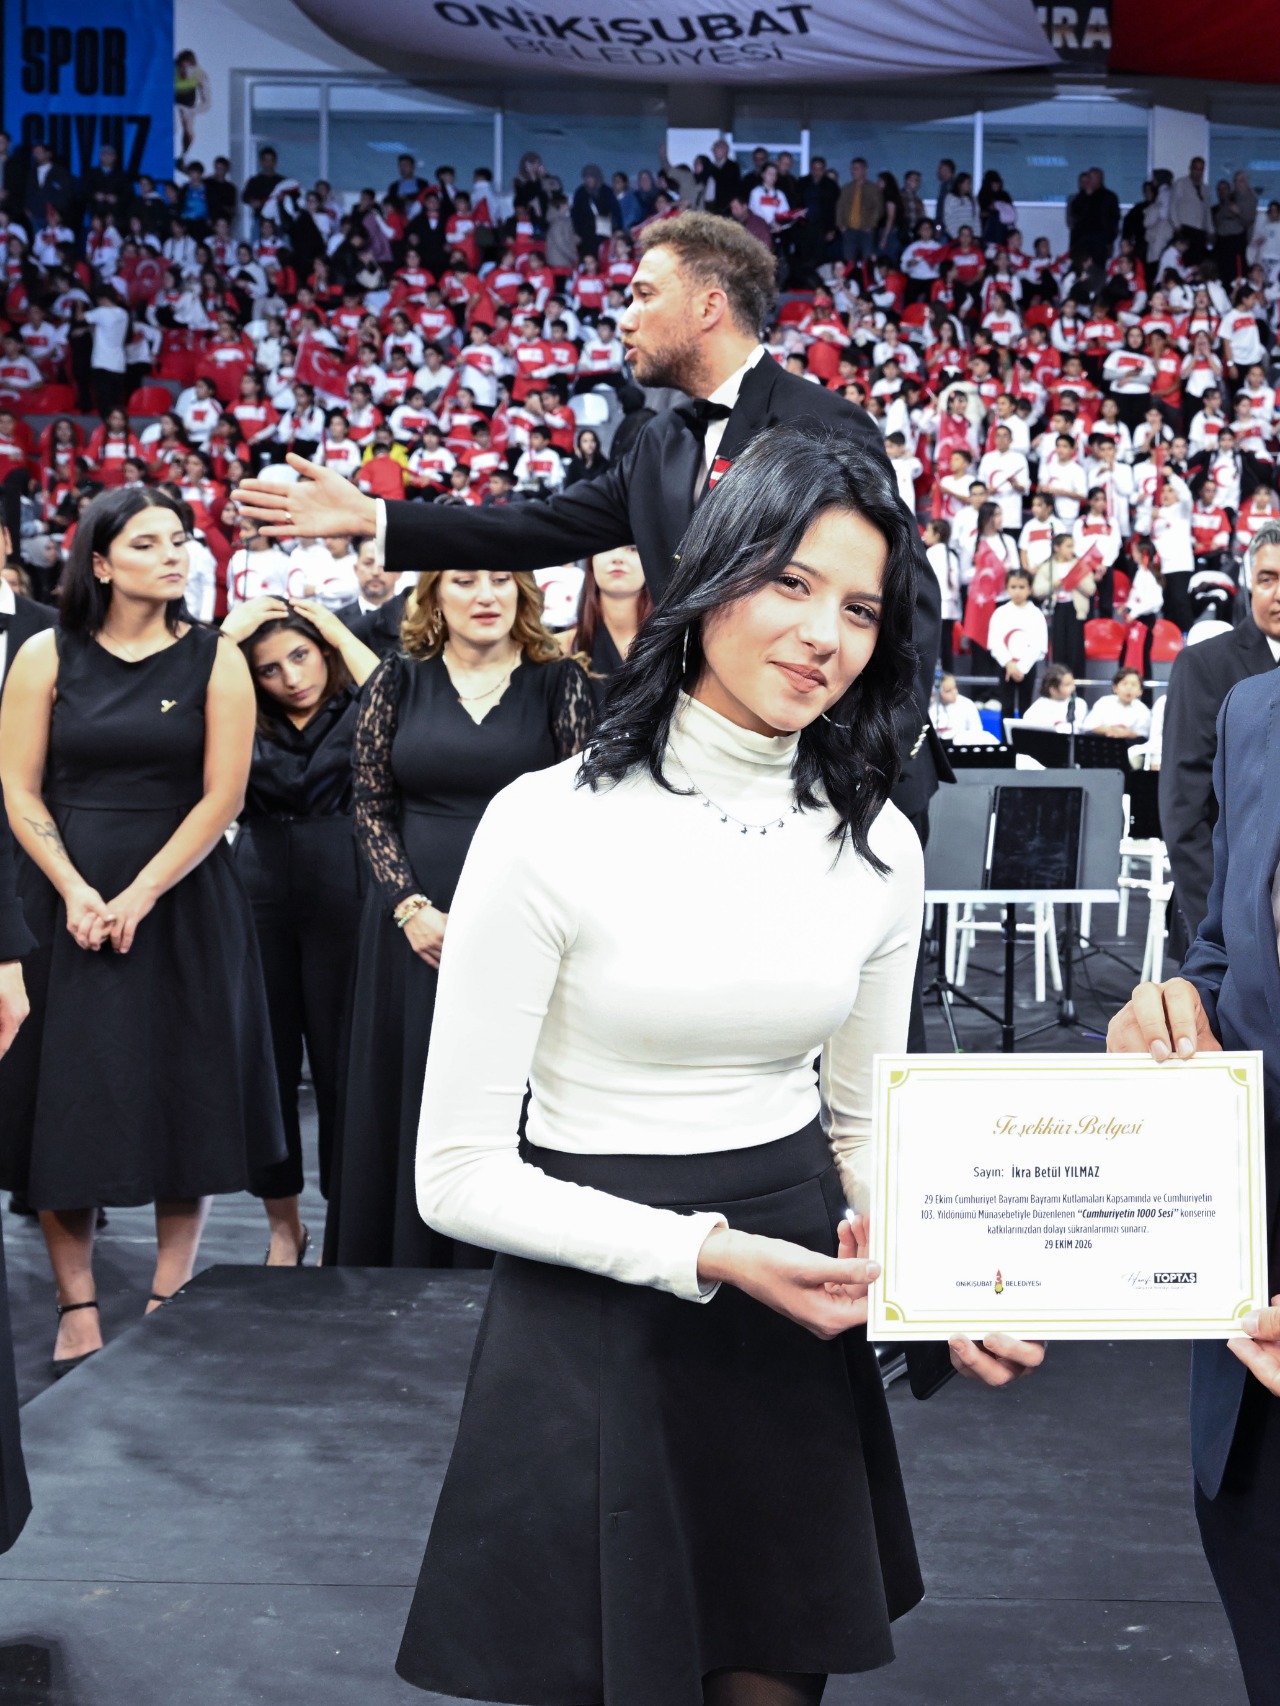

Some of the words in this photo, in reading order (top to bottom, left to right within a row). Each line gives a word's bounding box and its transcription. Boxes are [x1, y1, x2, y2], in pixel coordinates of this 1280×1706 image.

[22, 27, 126, 96] SPOR
[993, 1114, 1073, 1138] Teşekkür
[1074, 1114, 1145, 1141] Belgesi
[973, 1166, 1004, 1179] Sayın:
[1011, 1164, 1031, 1178] İkra
[1034, 1165, 1061, 1178] Betül
[1064, 1165, 1100, 1178] YILMAZ
[924, 1194, 934, 1204] 29
[935, 1194, 953, 1204] Ekim
[954, 1194, 997, 1206] Cumhuriyet
[998, 1194, 1029, 1205] Bayramı
[1030, 1193, 1061, 1205] Bayramı
[1062, 1193, 1105, 1204] Kutlamaları
[1106, 1193, 1151, 1205] Kapsamında
[1153, 1195, 1162, 1203] ve
[1163, 1192, 1213, 1204] Cumhuriyetin
[921, 1209, 935, 1220] 103.
[937, 1209, 976, 1220] Yıldönümü
[978, 1209, 1031, 1220] Münasebetiyle
[1032, 1208, 1075, 1219] Düzenlenen
[1136, 1208, 1156, 1218] 1000
[1180, 1207, 1216, 1218] konserine
[987, 1224, 1042, 1235] katkılarınızdan
[1043, 1224, 1066, 1235] dolayı
[1044, 1239, 1053, 1249] 29
[1055, 1237, 1073, 1249] EKİM
[1074, 1239, 1093, 1249] 2026
